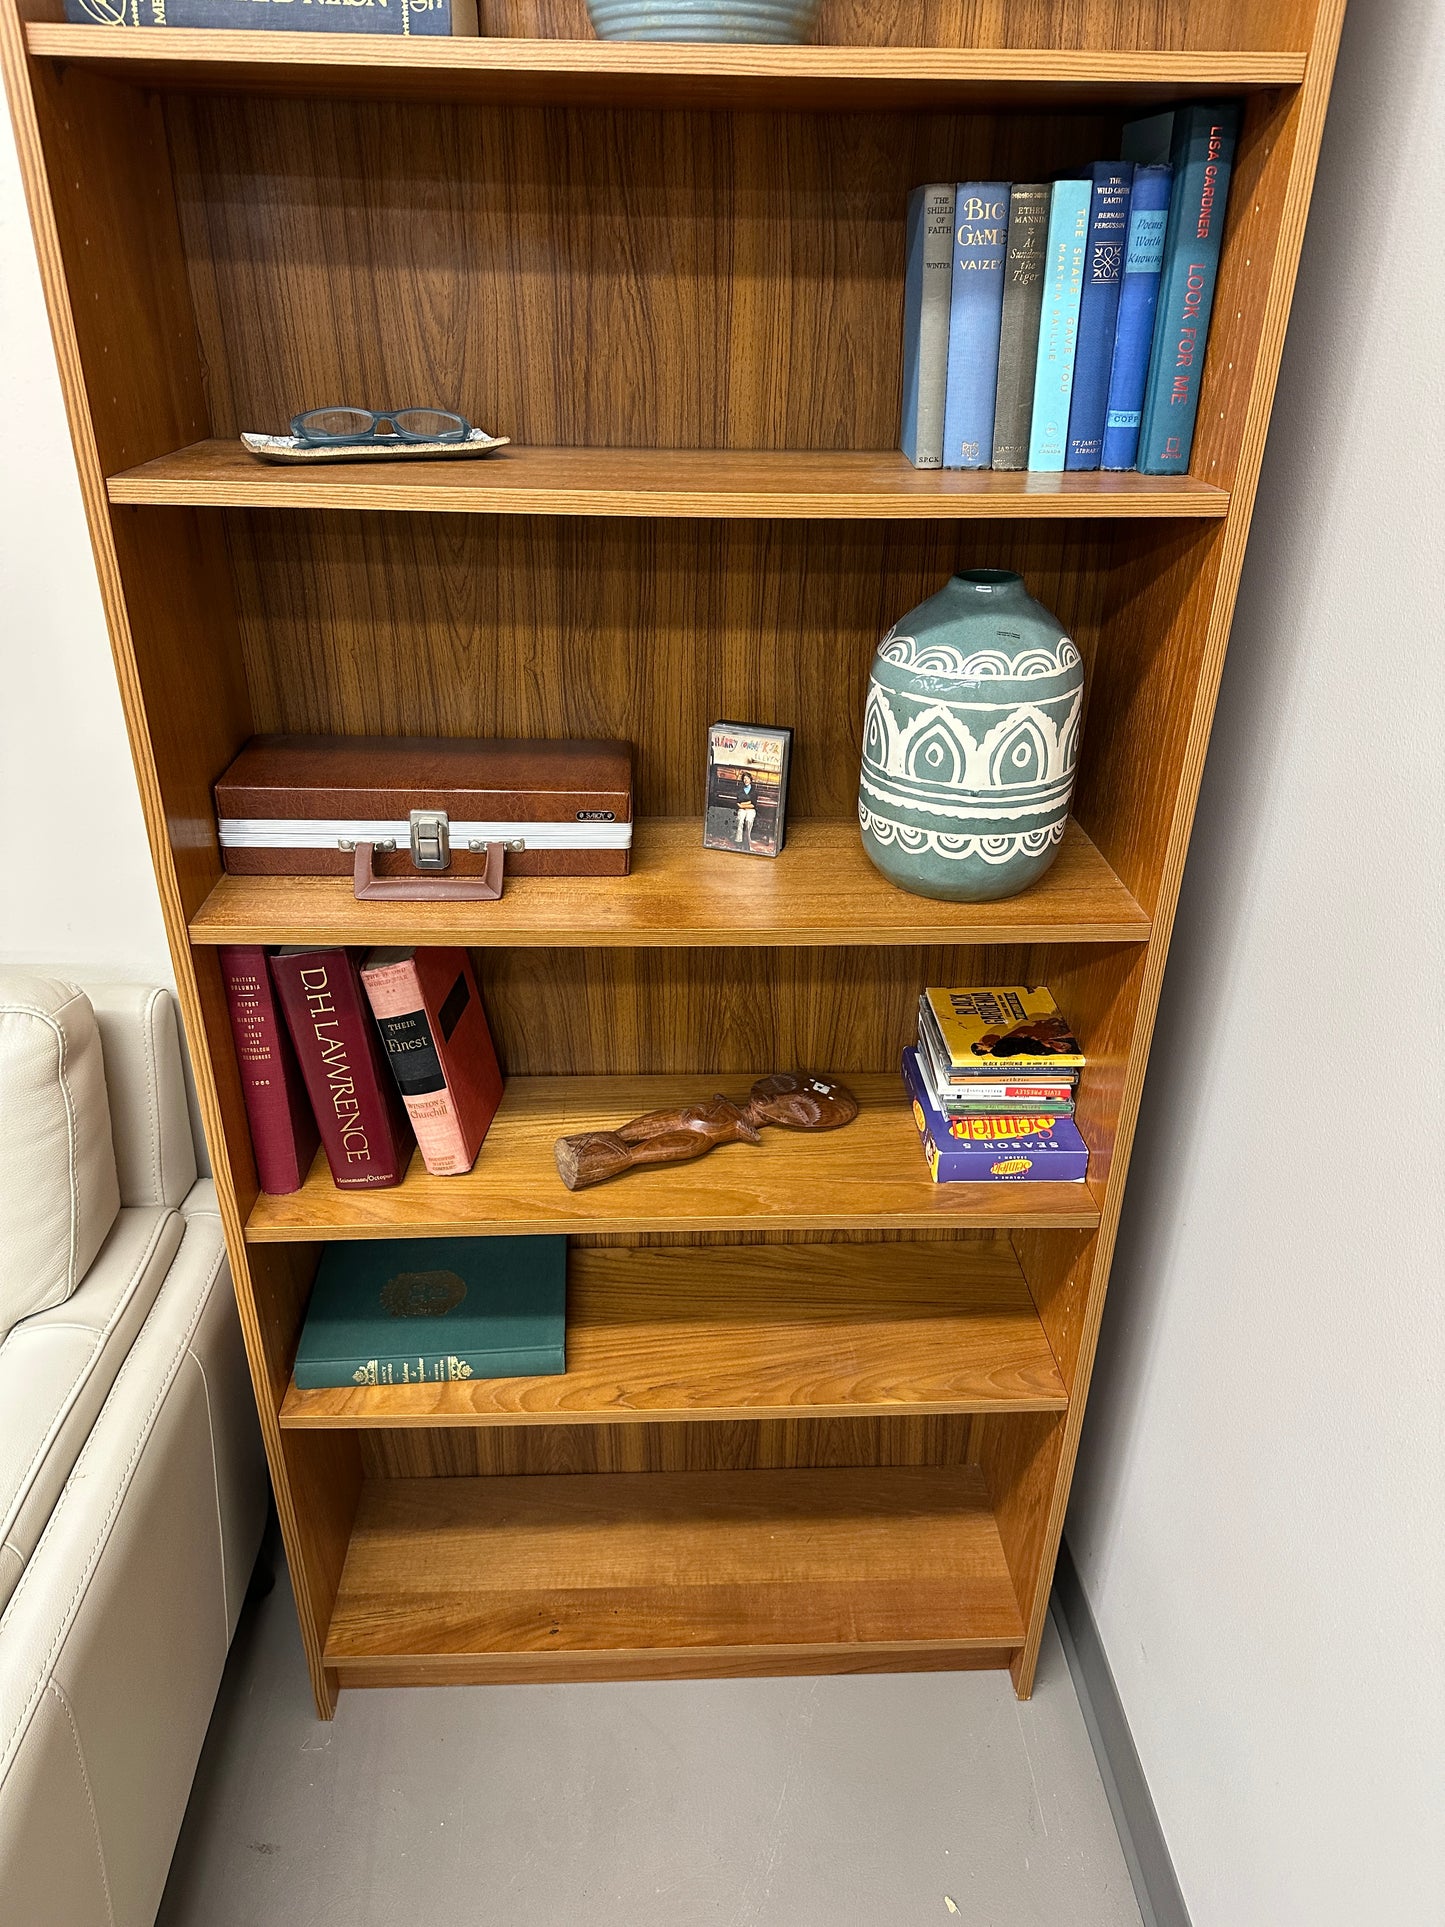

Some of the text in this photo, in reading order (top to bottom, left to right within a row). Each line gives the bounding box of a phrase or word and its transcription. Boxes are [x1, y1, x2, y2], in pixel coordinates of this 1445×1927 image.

[1196, 126, 1223, 239] LISA GARDNER
[964, 198, 1006, 220] BIG
[1018, 206, 1046, 215] ETHEL
[928, 226, 952, 234] FAITH
[1076, 208, 1086, 237] THE
[1137, 219, 1163, 230] Poems
[957, 225, 1008, 246] GAME
[1023, 238, 1035, 247] At
[1135, 236, 1161, 246] Worth
[960, 260, 1003, 270] VAIZEY
[1020, 261, 1036, 270] the
[1128, 253, 1163, 265] Knowing
[1012, 270, 1039, 285] Tiger
[1069, 247, 1082, 295] SHAPE
[1048, 243, 1067, 360] MARTHA BAILLIE
[1064, 317, 1075, 353] GAVE
[1171, 264, 1206, 405] LOOK FOR ME
[1060, 363, 1071, 392] YOU
[382, 967, 406, 978] SECOND
[367, 979, 391, 988] WORLD
[949, 994, 979, 1014] BLACK
[970, 992, 1006, 1024] GARDENIA
[388, 1020, 416, 1031] THEIR
[386, 1036, 428, 1053] Finest
[299, 966, 371, 1163] D.H. LAWRENCE
[408, 1100, 439, 1109] WINSTON
[410, 1105, 448, 1119] Churchill
[952, 1116, 1054, 1140] Seinfeld
[991, 1162, 1029, 1175] Seinfeld
